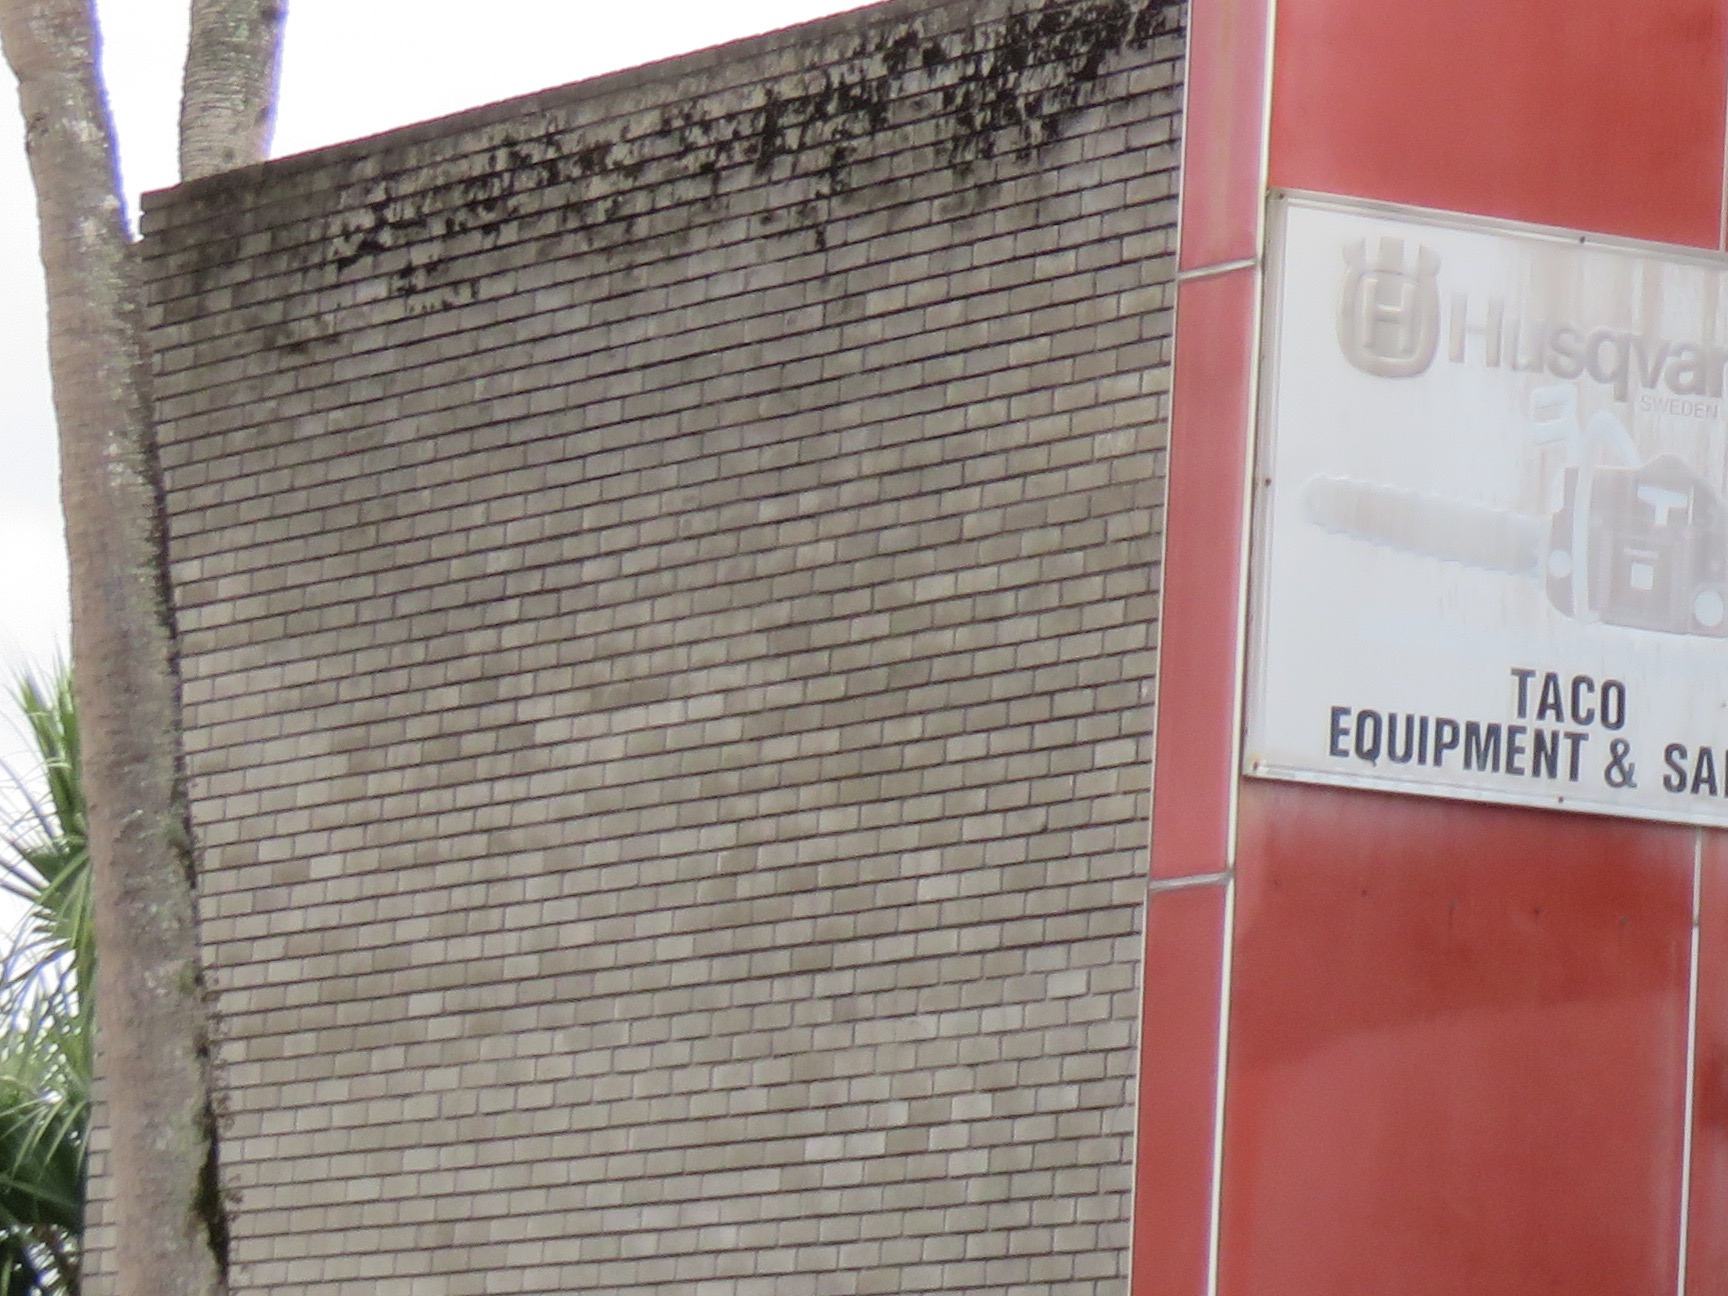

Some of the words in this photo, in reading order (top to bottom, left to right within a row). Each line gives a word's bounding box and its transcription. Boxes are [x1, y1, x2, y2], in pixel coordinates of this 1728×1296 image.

[1640, 395, 1718, 420] SWEDEN
[1510, 667, 1627, 731] TACO
[1327, 706, 1590, 782] EQUIPMENT
[1603, 738, 1638, 790] &
